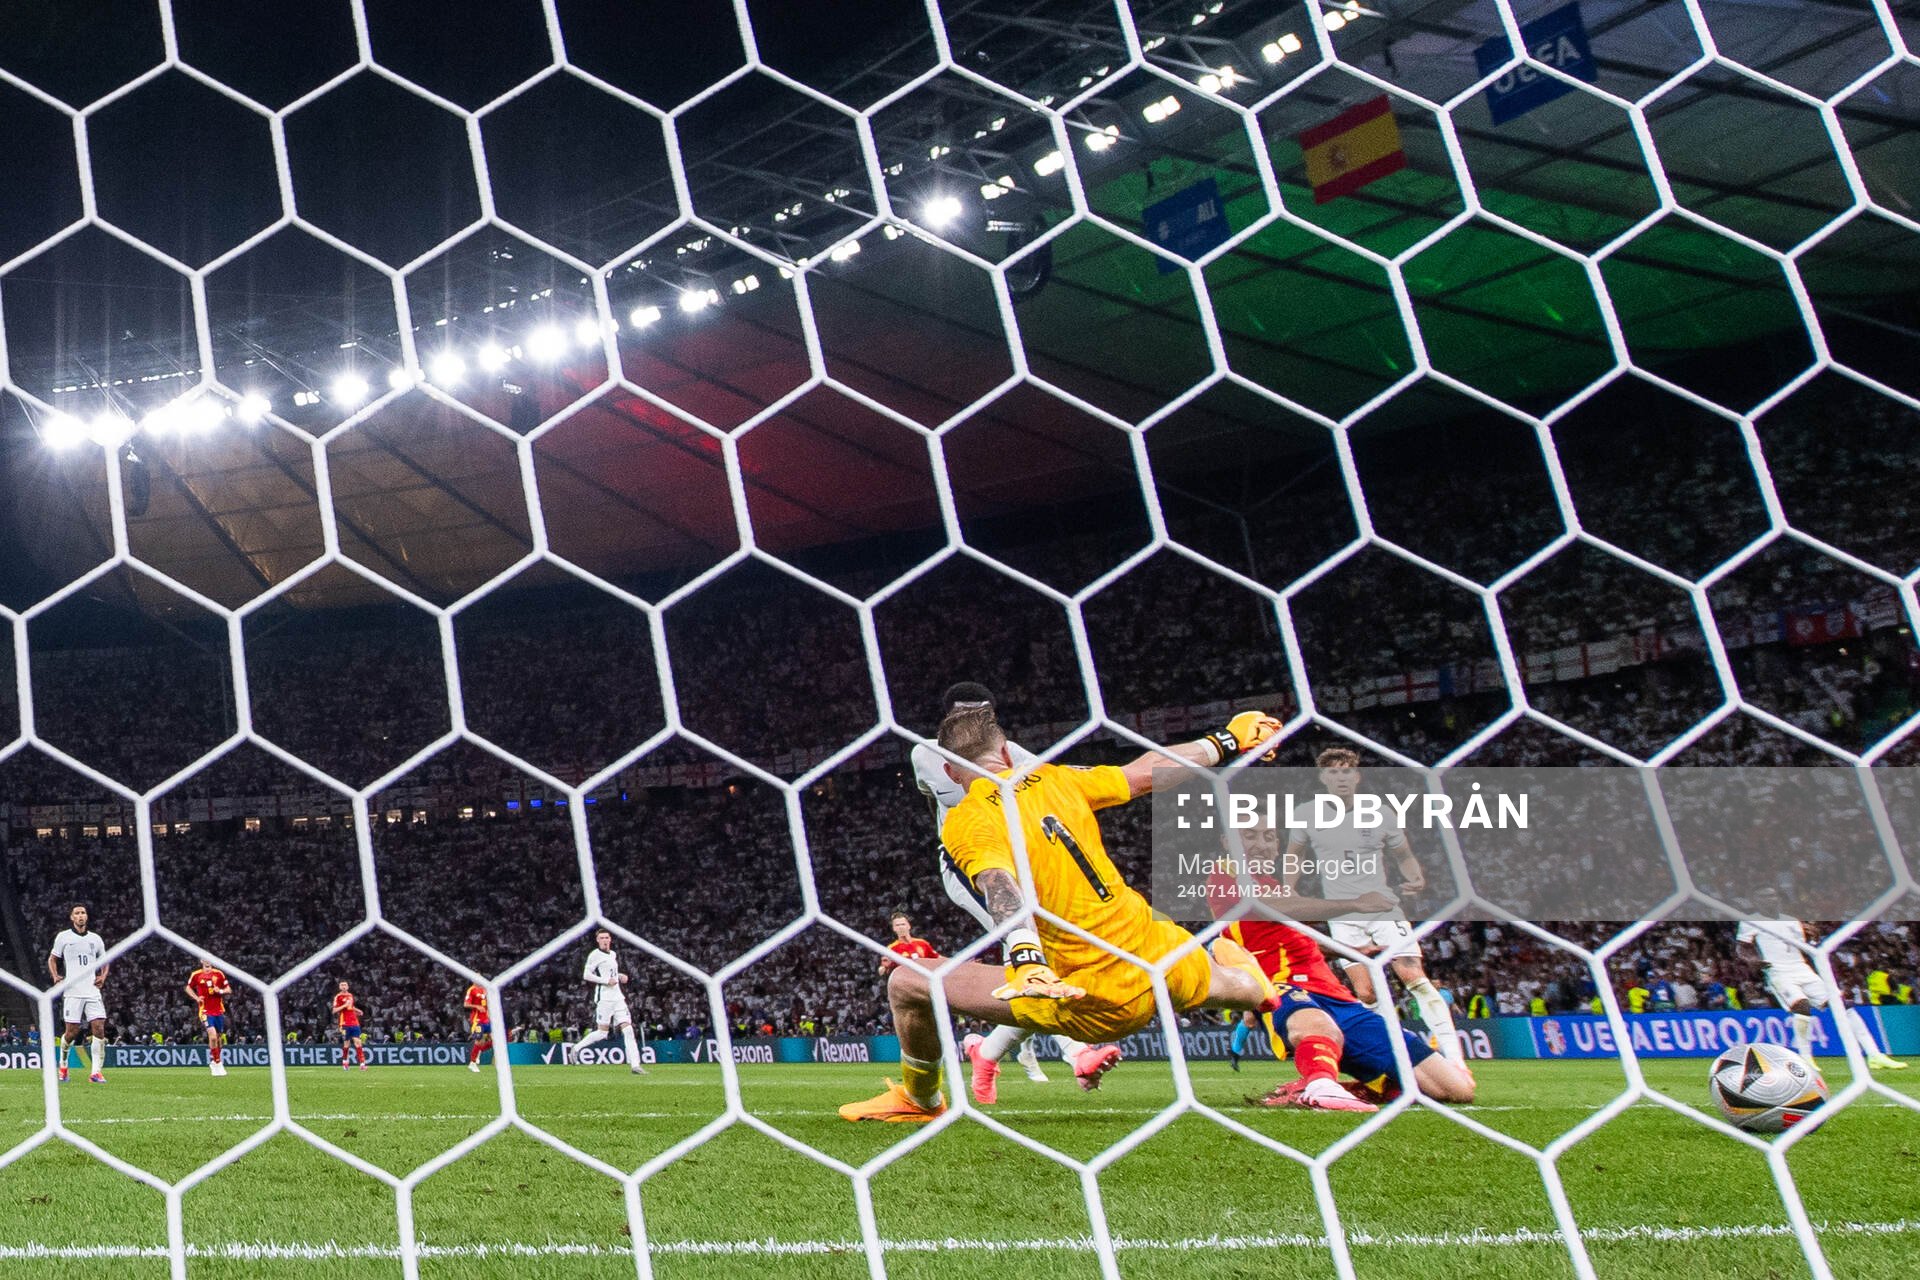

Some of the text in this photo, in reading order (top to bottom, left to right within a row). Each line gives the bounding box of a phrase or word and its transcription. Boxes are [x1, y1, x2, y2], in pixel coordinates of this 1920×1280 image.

[1216, 732, 1237, 750] JP
[1041, 815, 1114, 902] 1
[78, 955, 88, 966] 10
[1571, 1020, 1654, 1052] UEA
[1650, 1016, 1747, 1051] EURO
[116, 1049, 202, 1066] REXONA
[285, 1047, 327, 1064] THE
[331, 1046, 466, 1065] PROTECTION
[706, 1038, 773, 1062] Rexona
[820, 1036, 869, 1062] Rexona
